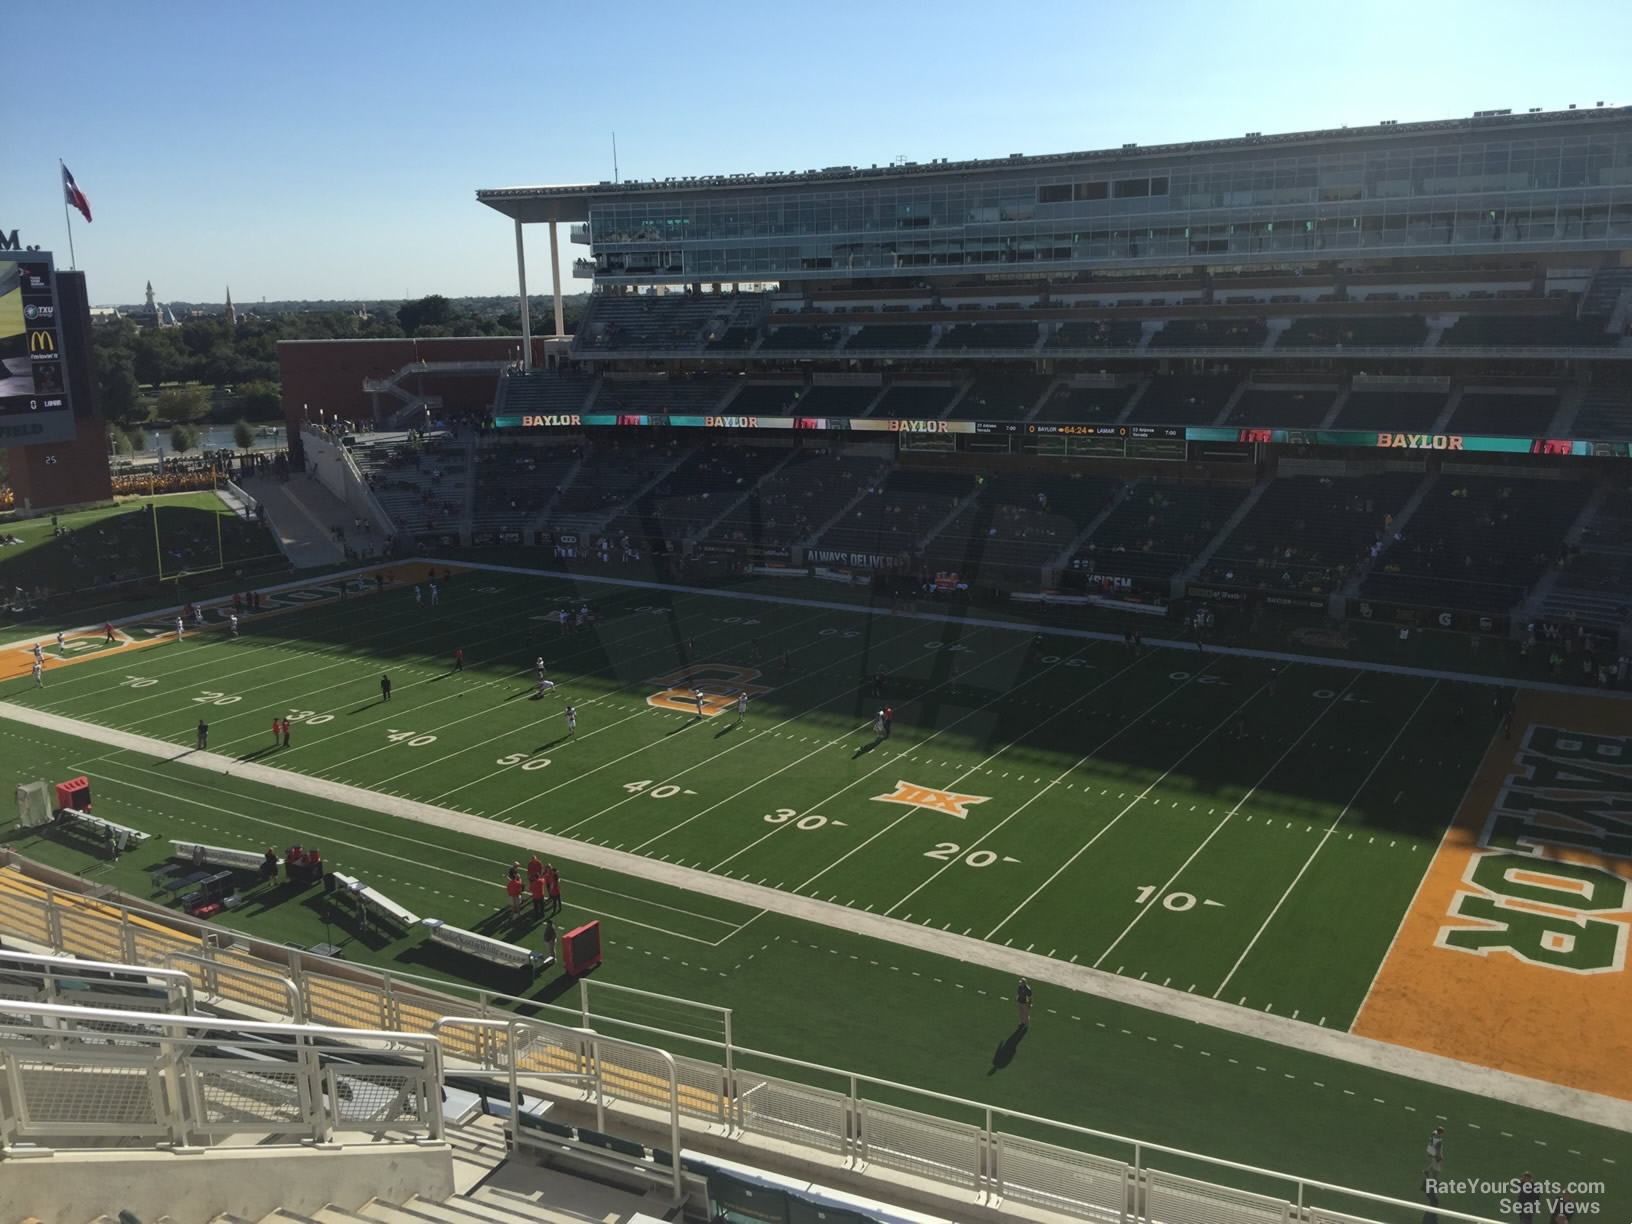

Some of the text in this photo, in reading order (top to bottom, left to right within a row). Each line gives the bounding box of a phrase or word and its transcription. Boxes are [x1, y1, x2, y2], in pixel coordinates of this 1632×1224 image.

[38, 306, 54, 314] TXU
[522, 415, 581, 426] BAYLOR
[704, 416, 759, 428] BAYLOR
[889, 420, 948, 432] BAYLOR
[1377, 433, 1464, 451] BAYLOR
[45, 455, 57, 465] 25
[808, 550, 849, 565] ALWAYS
[192, 691, 242, 705] 20
[286, 710, 335, 725] 30
[387, 730, 438, 746] 40
[496, 753, 551, 770] 50
[622, 779, 681, 798] 40
[764, 808, 828, 830] 30
[923, 842, 998, 867] 20
[1433, 722, 1632, 976] BAYLOR
[1134, 885, 1203, 912] 10
